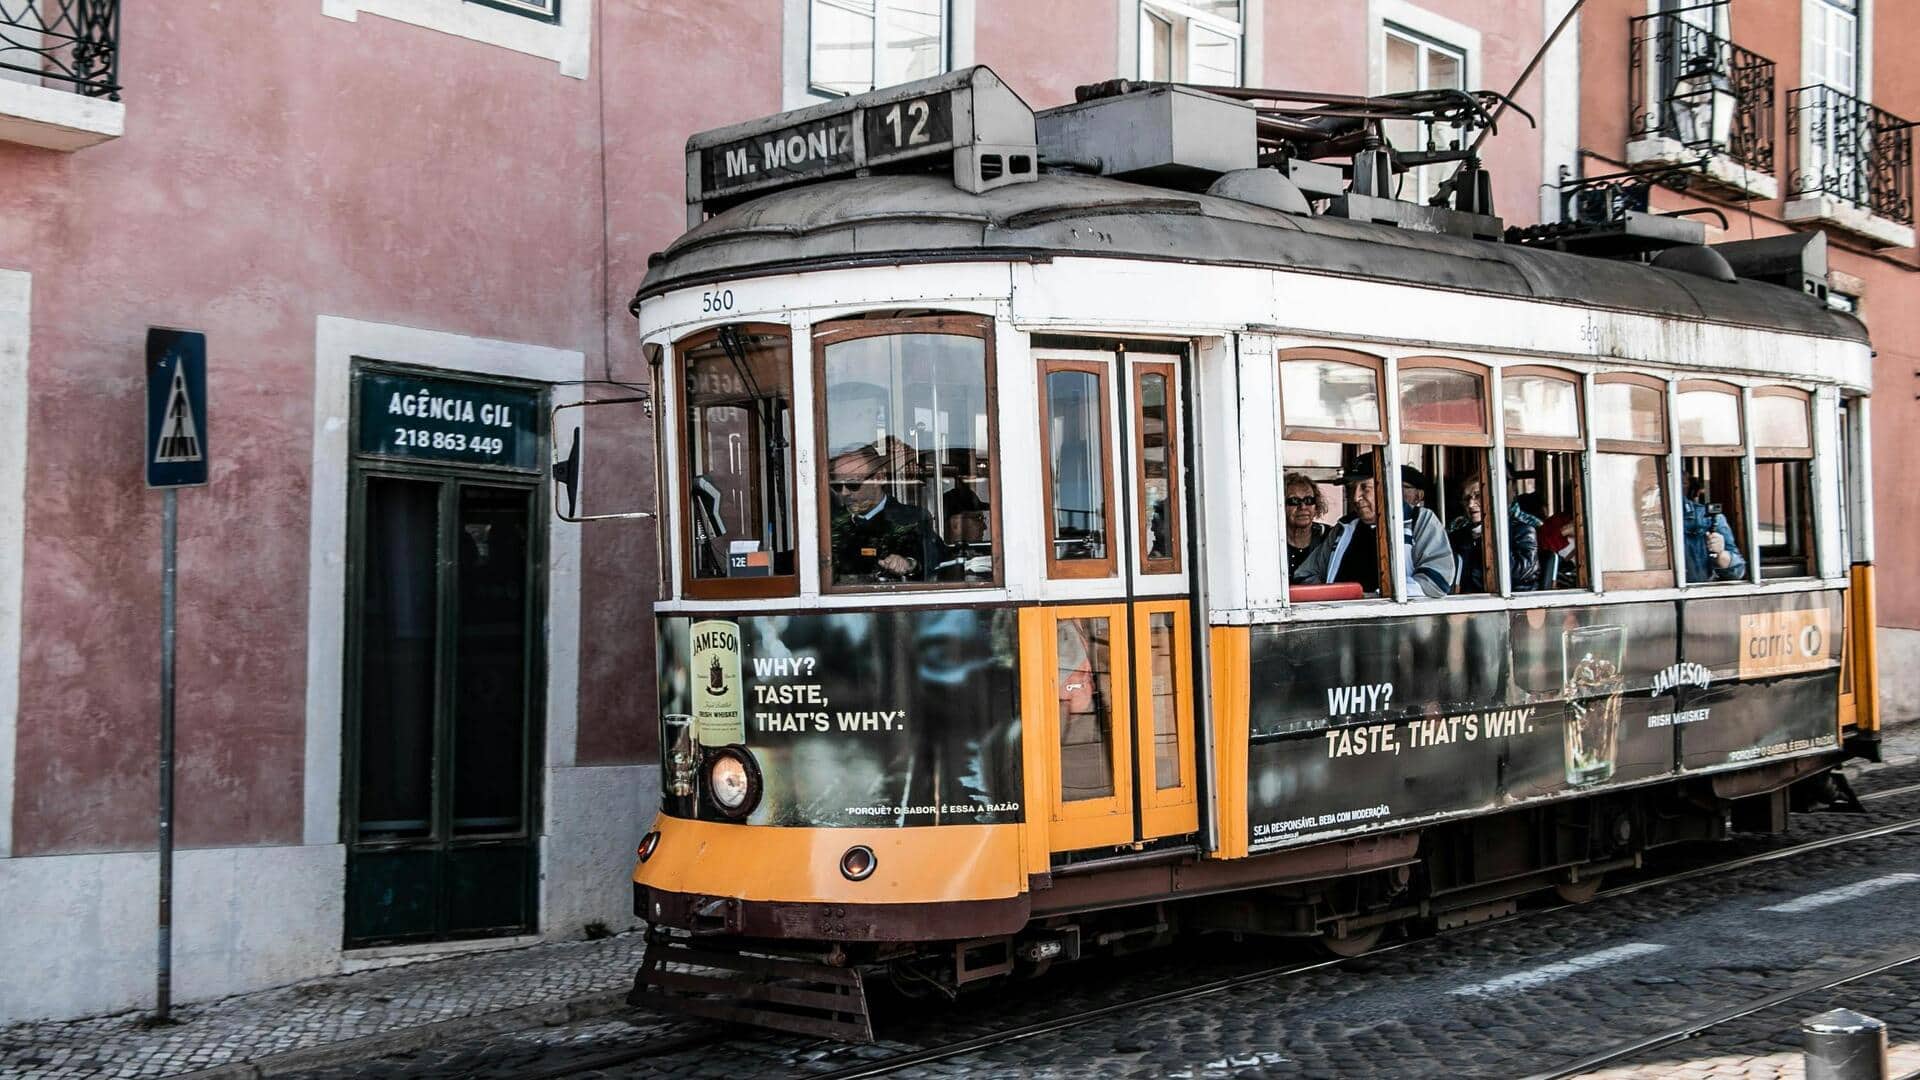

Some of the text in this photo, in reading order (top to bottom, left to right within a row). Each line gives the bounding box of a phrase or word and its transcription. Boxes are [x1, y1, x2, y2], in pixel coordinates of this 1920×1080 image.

[886, 100, 930, 147] 12
[726, 125, 850, 178] M. MONIZ
[703, 289, 733, 312] 560
[1580, 325, 1599, 342] 560
[388, 388, 512, 427] AGÊNCIA GIL
[394, 427, 503, 455] 218 863 449
[731, 557, 746, 567] 12E
[693, 631, 738, 656] JAMESON
[1749, 626, 1793, 658] carris
[753, 657, 816, 676] WHY?
[1650, 662, 1713, 697] JAMESON
[754, 684, 828, 707] TASTE,
[1327, 682, 1393, 716] WHY?
[755, 712, 830, 732] THAT'S
[1647, 708, 1711, 728] IRISH WHISKEY
[1325, 723, 1401, 757] TASTE,
[1408, 713, 1478, 748] THAT'S
[893, 806, 901, 815] O
[941, 803, 948, 814] É
[950, 804, 975, 813] ESSA
[977, 804, 984, 813] A
[986, 802, 1019, 813] RAZÃO
[1253, 825, 1270, 836] SEJA
[1271, 816, 1318, 833] RESPONSÁVEL.
[1319, 813, 1337, 826] BEBA
[1337, 811, 1351, 822] COM
